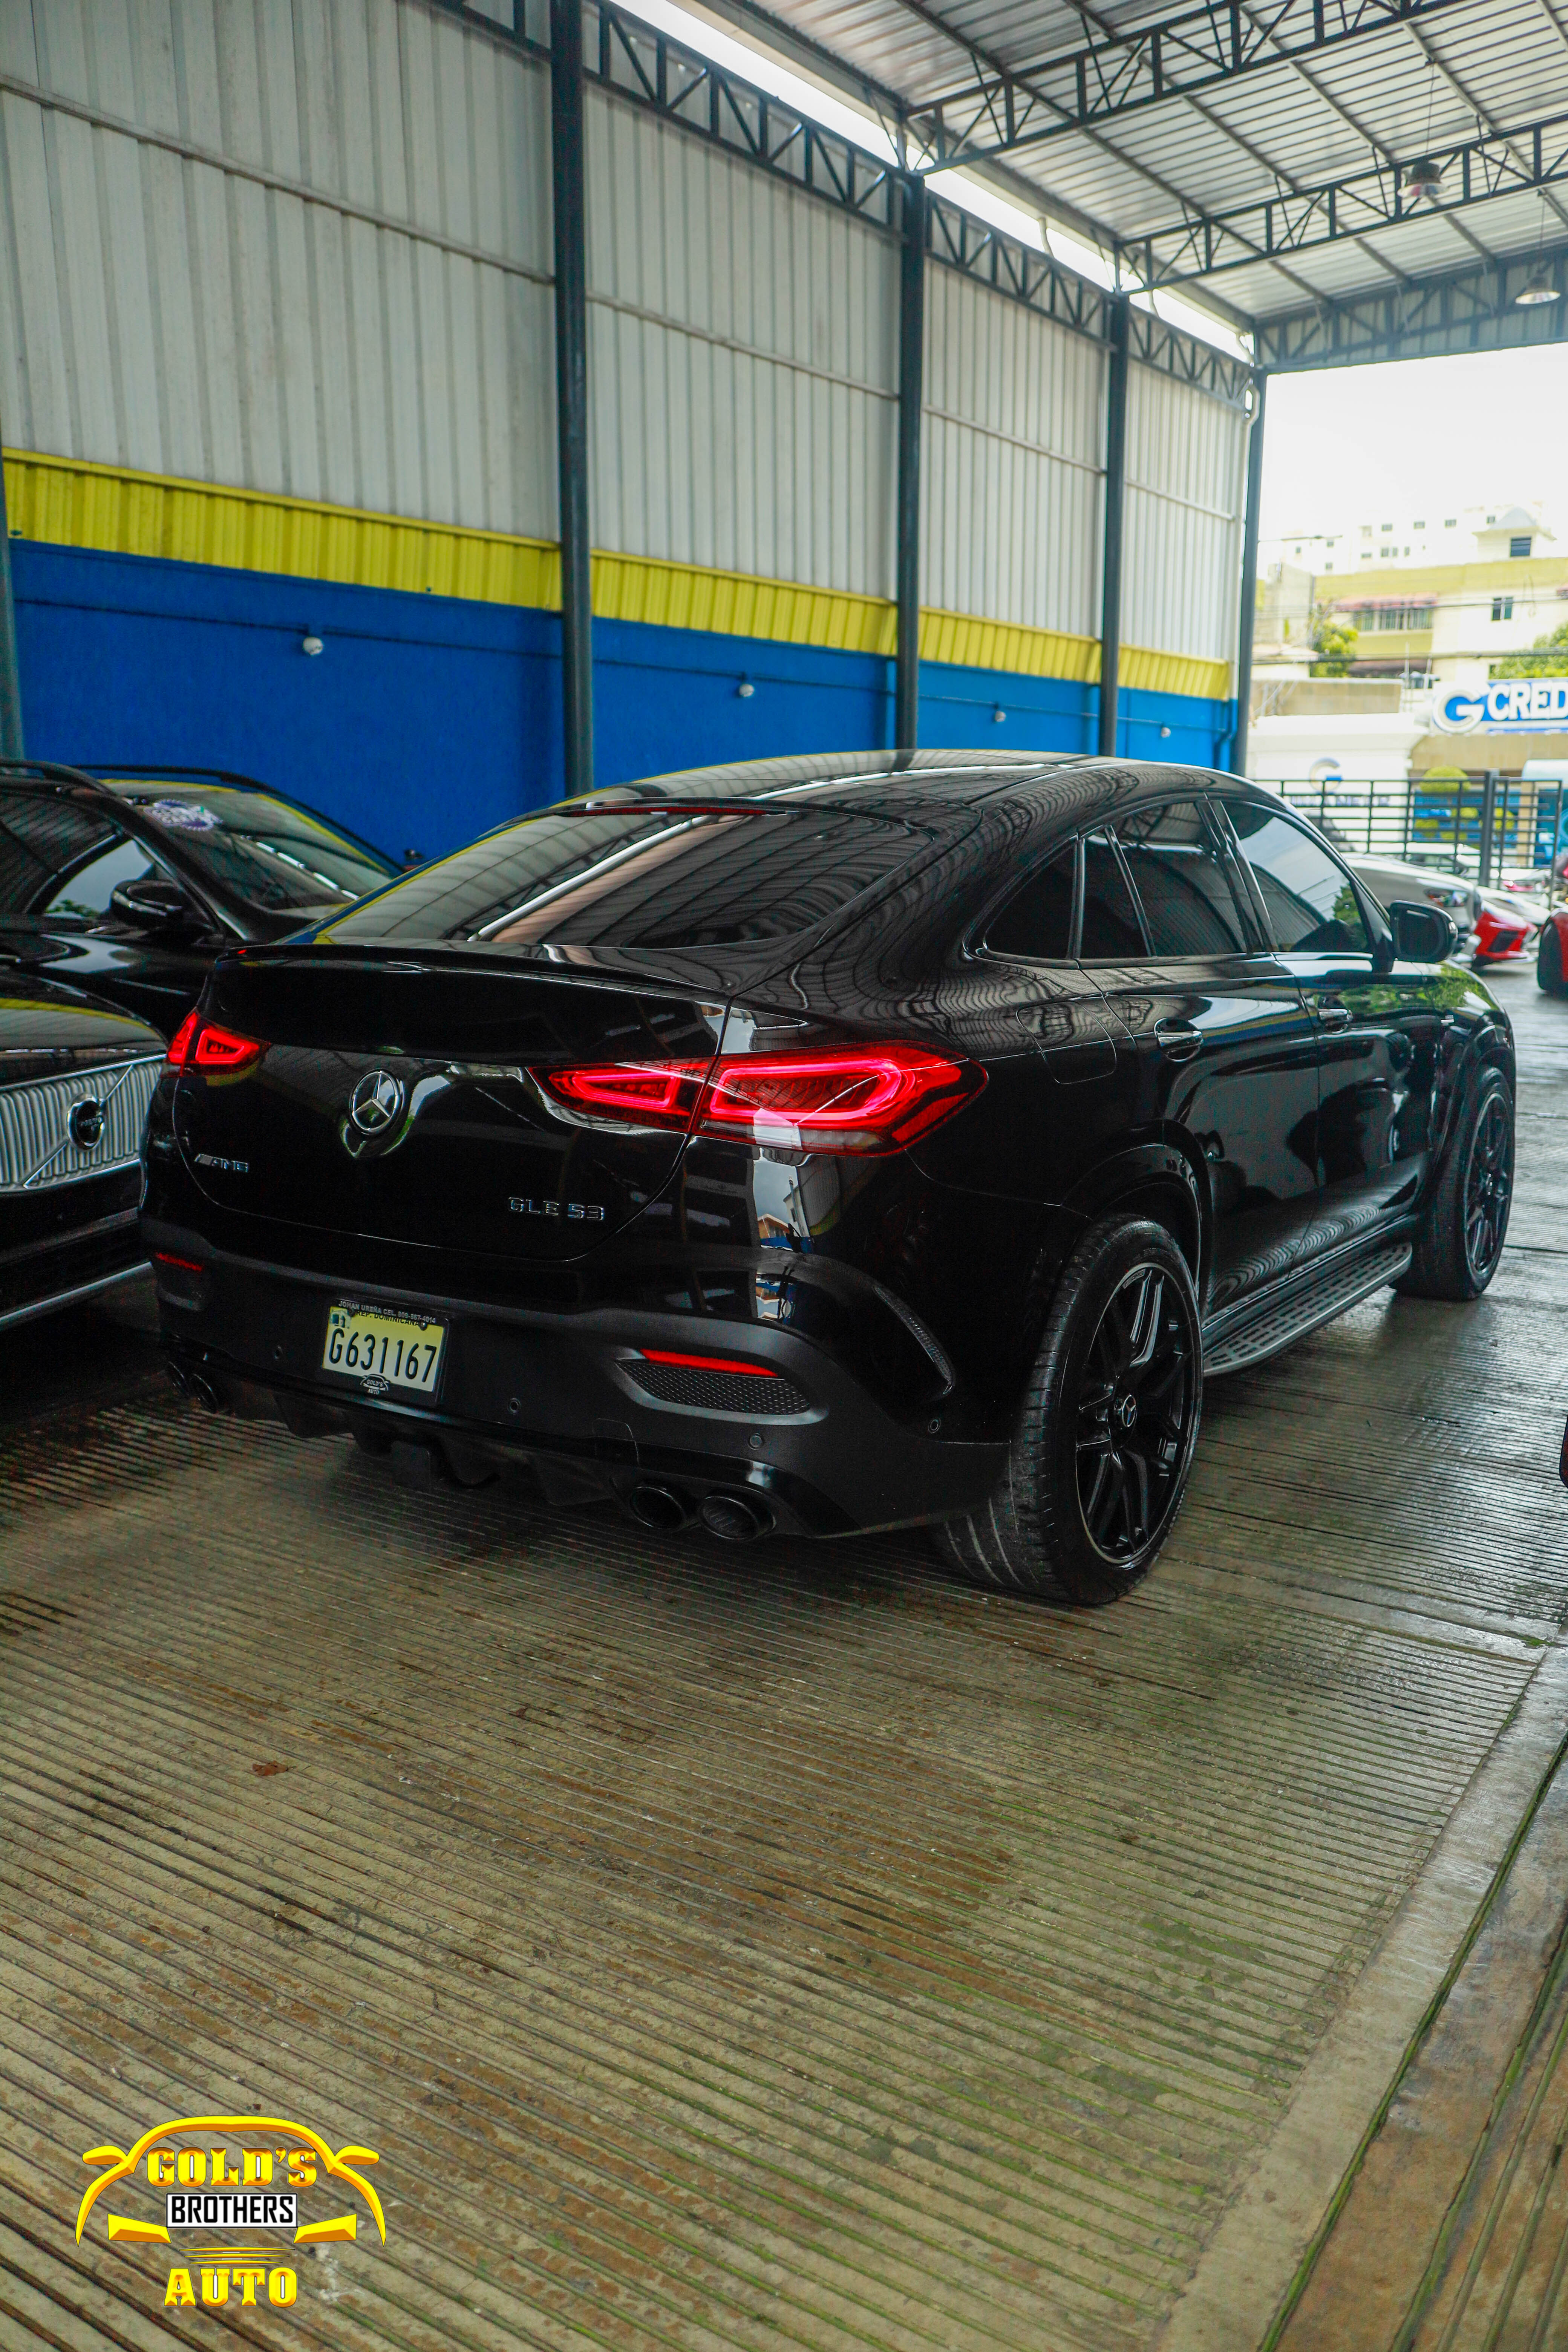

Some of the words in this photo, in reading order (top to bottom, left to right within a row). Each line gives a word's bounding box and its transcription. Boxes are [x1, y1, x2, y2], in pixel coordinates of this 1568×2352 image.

[508, 1196, 560, 1216] GLE
[567, 1203, 605, 1220] 53
[338, 1300, 360, 1310] JOHAN
[361, 1304, 381, 1314] UREÑA
[383, 1308, 396, 1317] CEL.
[328, 1328, 437, 1383] G631167
